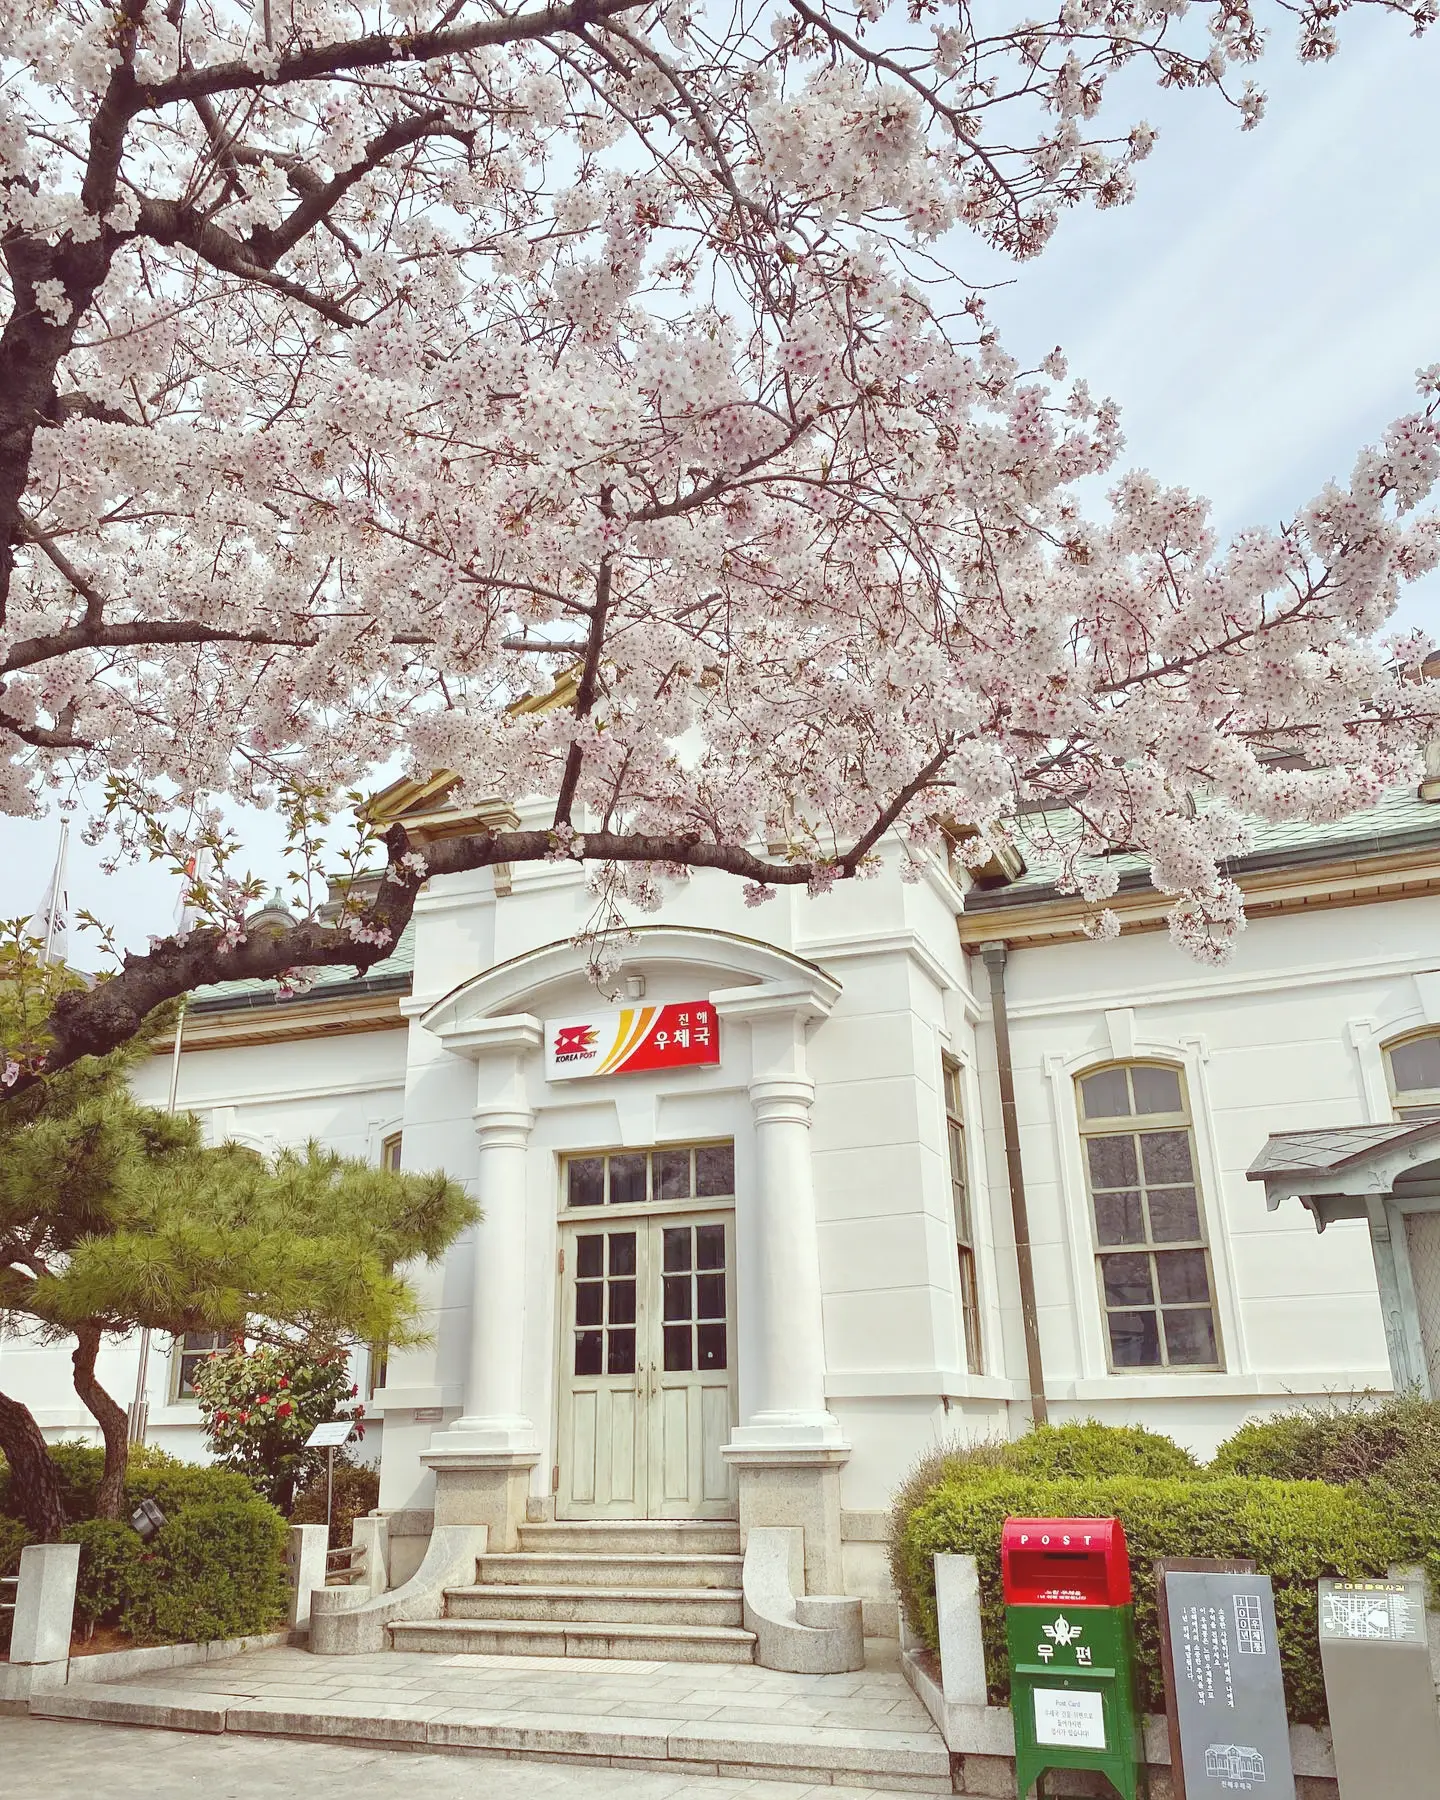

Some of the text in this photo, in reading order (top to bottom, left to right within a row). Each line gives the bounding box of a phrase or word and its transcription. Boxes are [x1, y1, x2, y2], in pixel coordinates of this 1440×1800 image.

[678, 1011, 708, 1026] 진해
[654, 1027, 710, 1050] 우체국
[556, 1051, 598, 1063] KOREA POST
[1021, 1534, 1092, 1546] POST
[1182, 1607, 1188, 1622] 1년
[1208, 1607, 1217, 1629] 추억을
[1238, 1598, 1249, 1640] 100년
[1251, 1620, 1262, 1652] 우체통
[1193, 1644, 1202, 1665] 소중한
[1199, 1607, 1215, 1699] 이 우체통은 느린 우체통으로
[1218, 1608, 1226, 1629] 소중한
[1226, 1686, 1235, 1708] 나에게
[1055, 1699, 1081, 1708] Post Card
